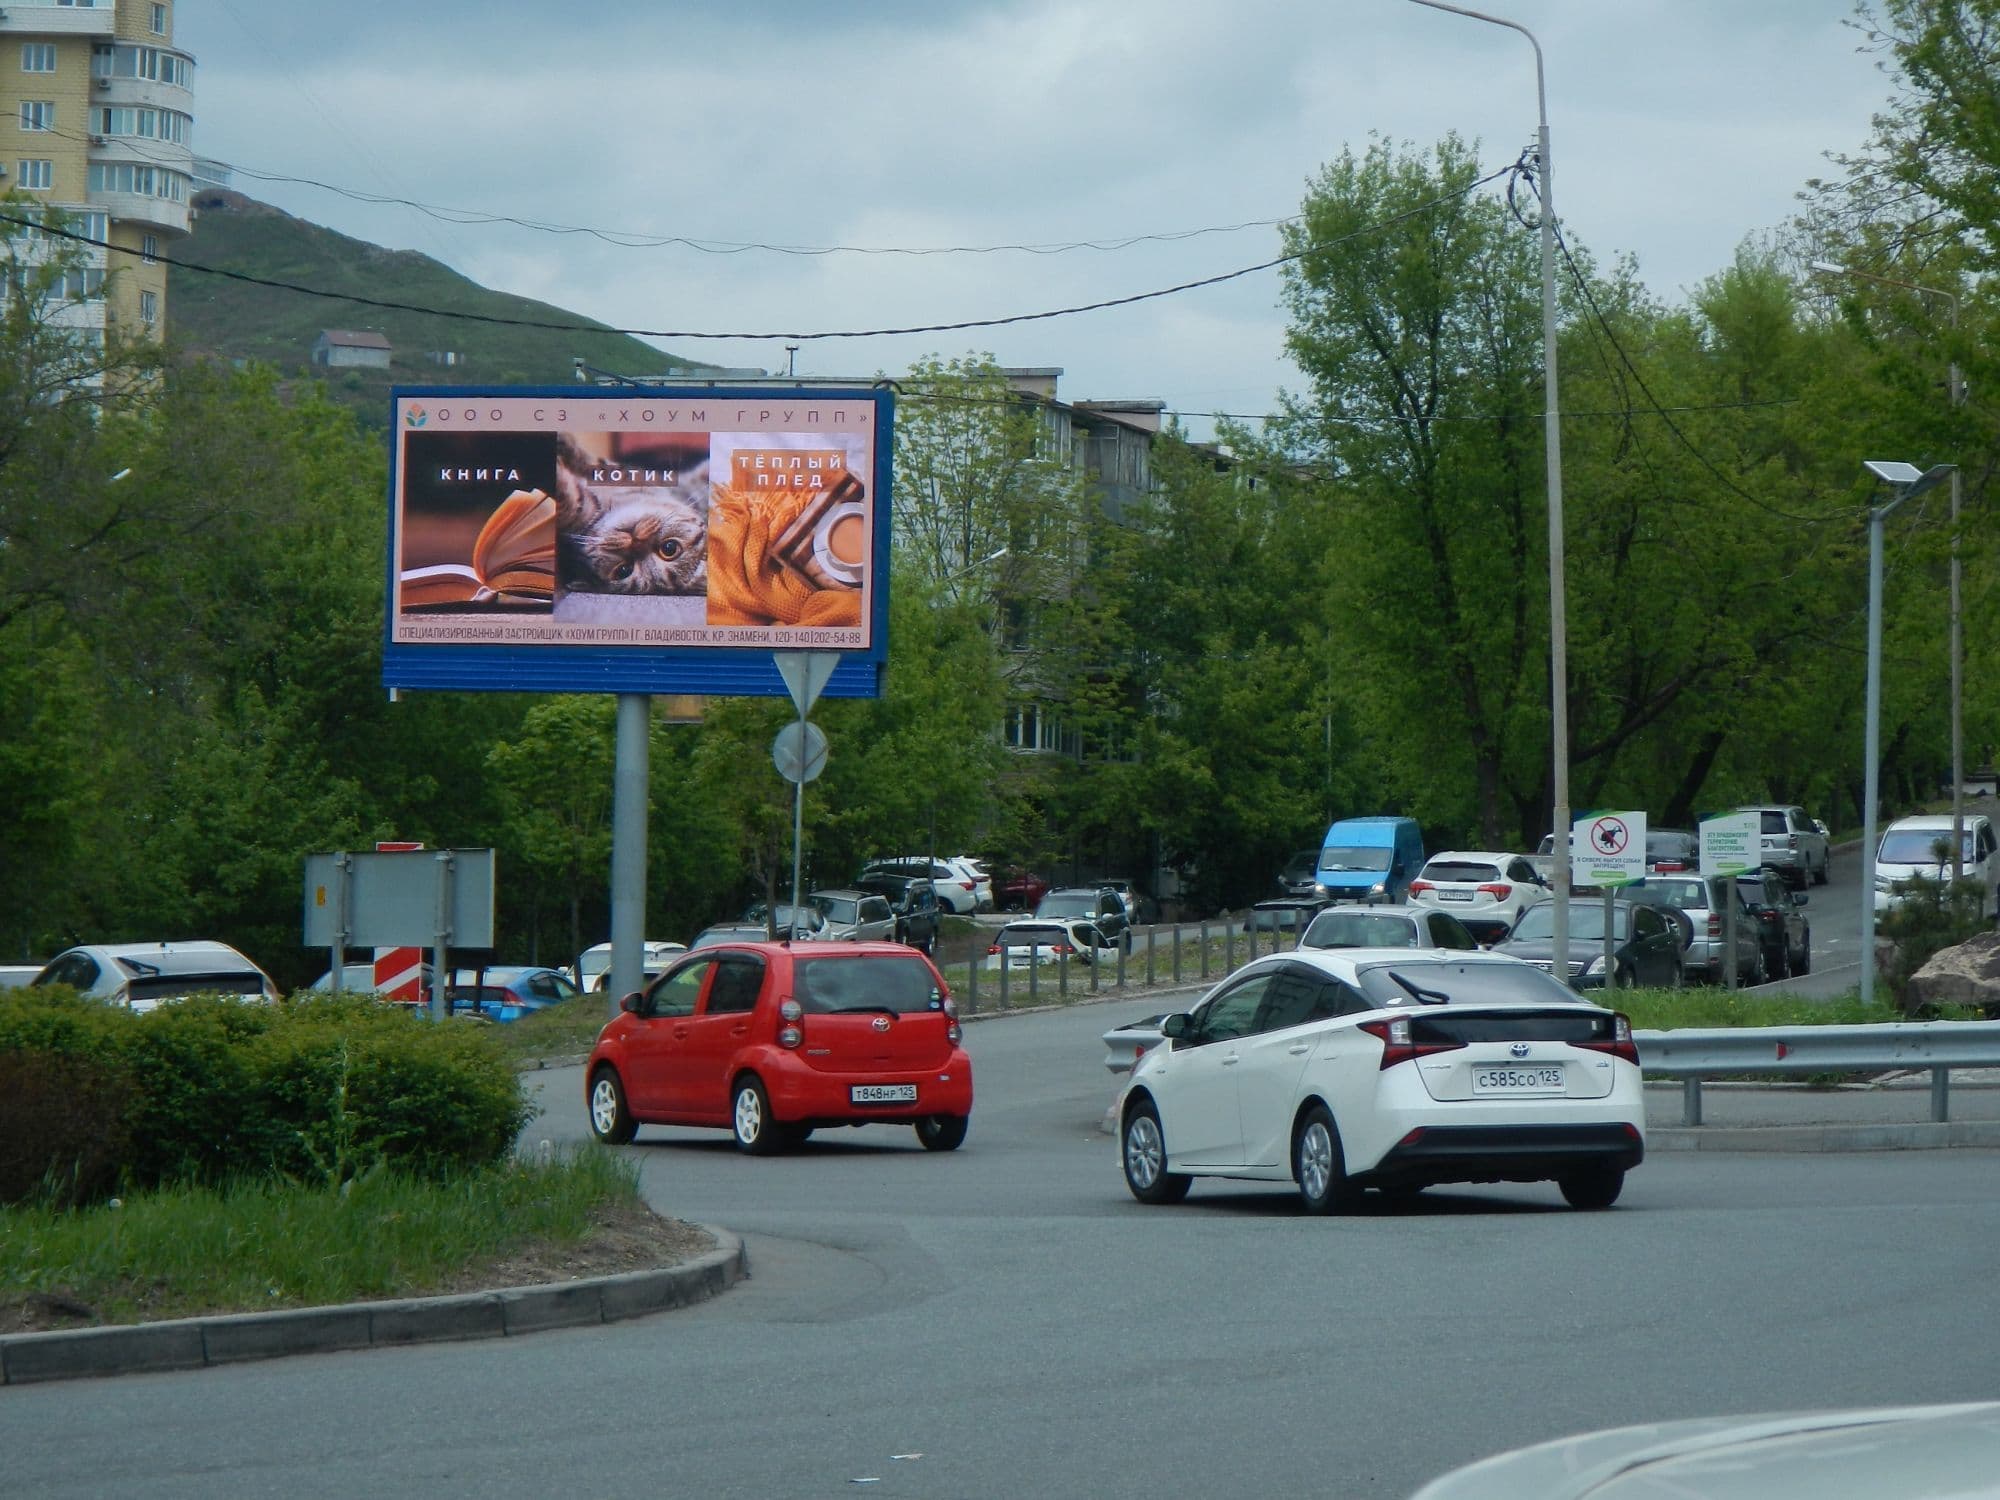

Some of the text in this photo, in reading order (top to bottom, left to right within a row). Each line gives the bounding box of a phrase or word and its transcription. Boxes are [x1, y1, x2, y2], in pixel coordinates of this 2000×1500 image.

[438, 409, 868, 423] ООО СЗ «ХОУМ ГРУПП»
[739, 454, 841, 469] ТЁПЛЫЙ
[441, 468, 520, 481] КНИГА
[593, 469, 674, 482] КОТИК
[758, 474, 823, 488] ПЛЕД
[399, 626, 503, 640] СПЕЦИАЛИЗИРОВАННЫЙ
[504, 627, 562, 641] ЗАСТРОЙЩИК
[1539, 1070, 1560, 1082] 125
[899, 1086, 914, 1096] 125
